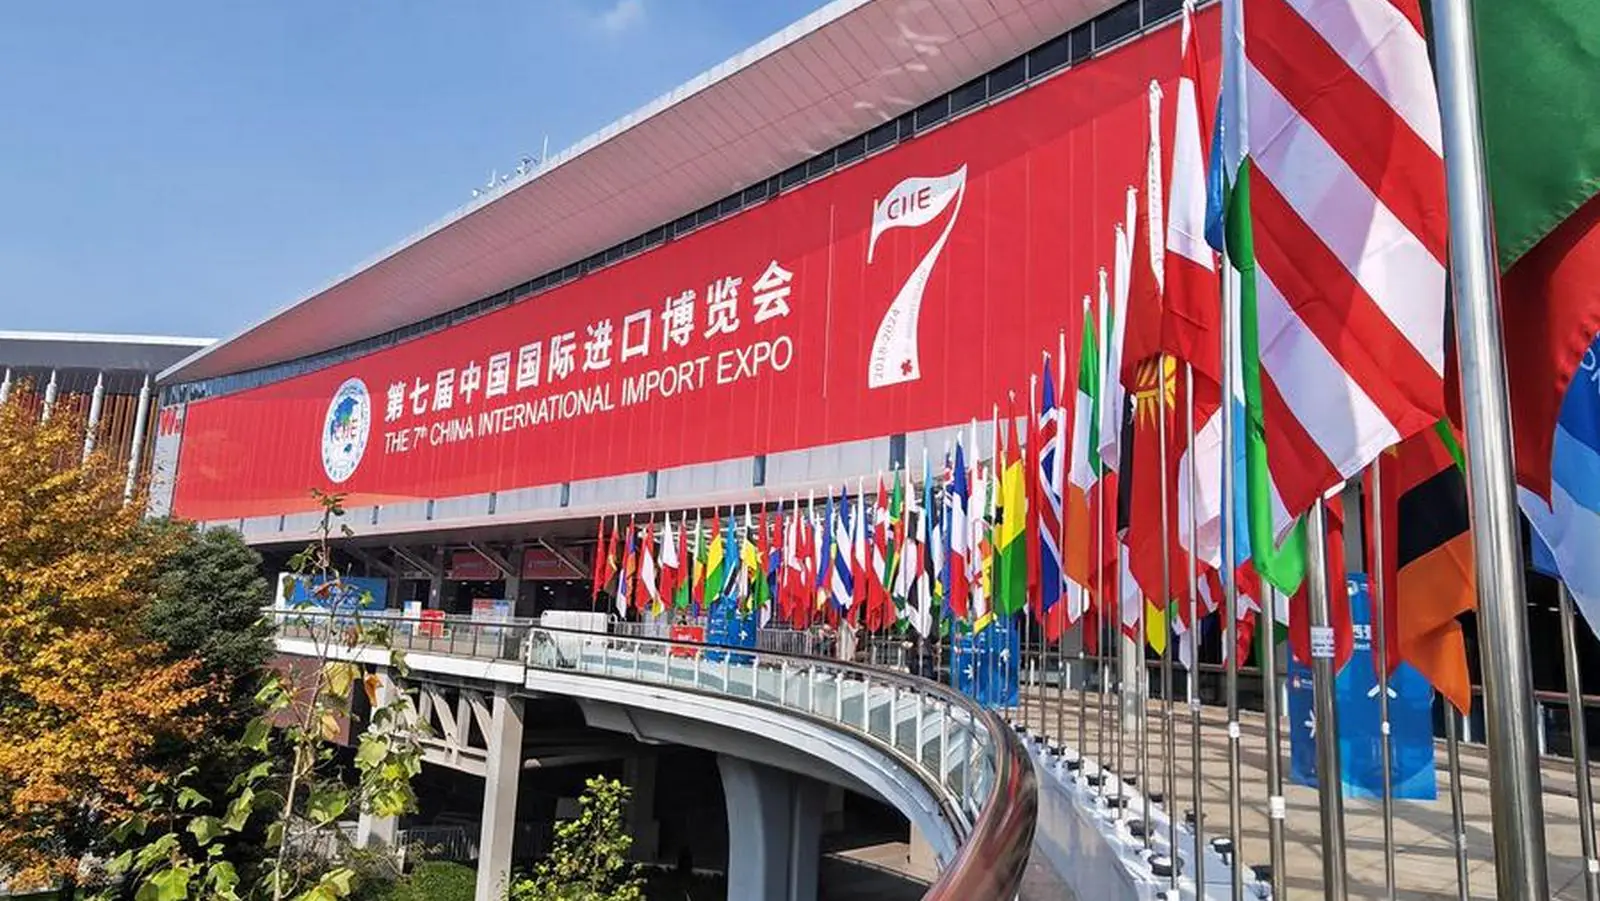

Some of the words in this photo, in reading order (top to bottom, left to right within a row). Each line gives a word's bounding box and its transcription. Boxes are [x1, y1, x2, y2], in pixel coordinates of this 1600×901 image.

[887, 187, 931, 220] CIIE
[385, 260, 794, 423] 第七届中国国际进口博览会
[873, 308, 901, 379] 2018-2024
[384, 428, 411, 454] THE
[430, 416, 474, 446] CHINA
[478, 382, 615, 437] INTERNATIONAL
[621, 356, 710, 407] IMPORT
[717, 335, 794, 385] EXPO
